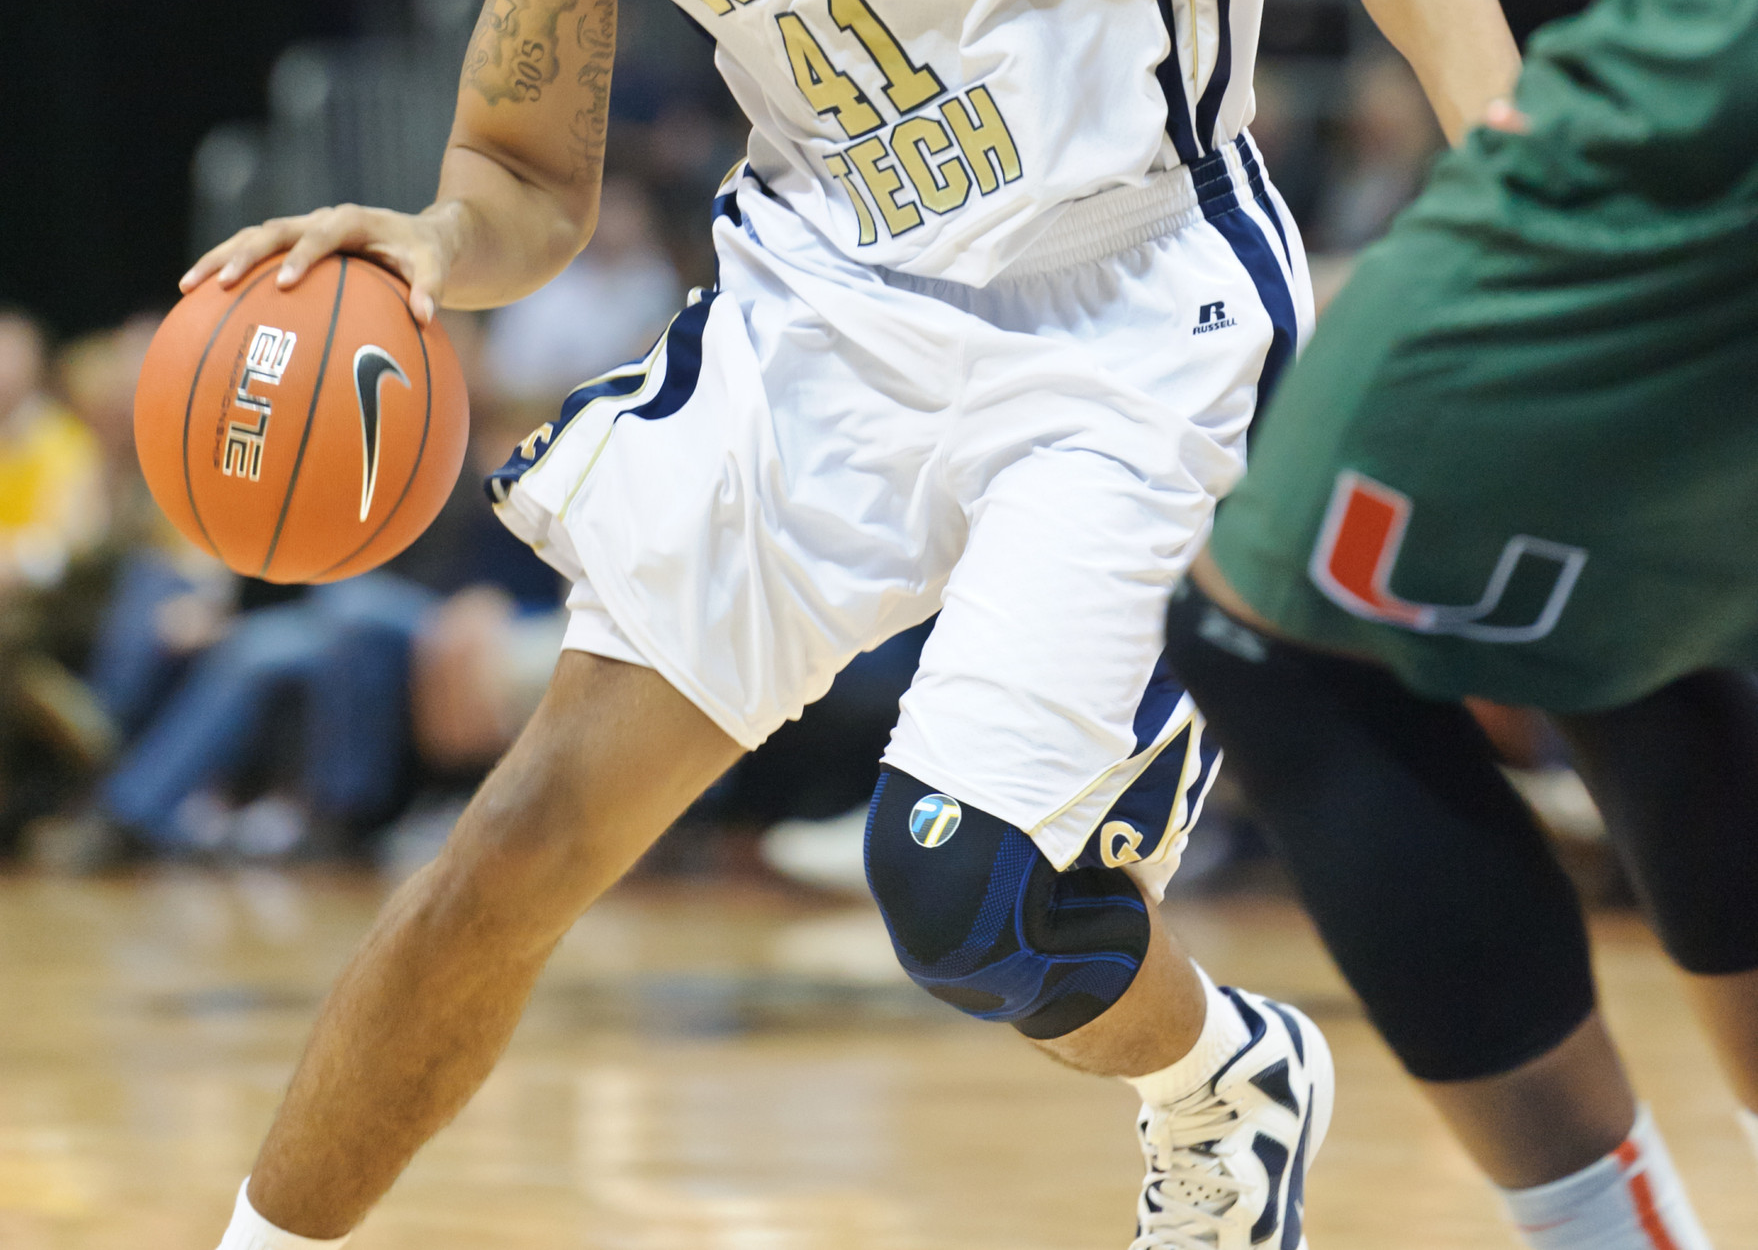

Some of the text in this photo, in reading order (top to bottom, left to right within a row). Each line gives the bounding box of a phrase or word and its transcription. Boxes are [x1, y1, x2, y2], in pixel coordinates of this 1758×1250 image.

[514, 39, 545, 103] 305
[823, 83, 1024, 247] TECH
[1192, 317, 1238, 336] RUSSELL
[222, 324, 298, 483] ELITE
